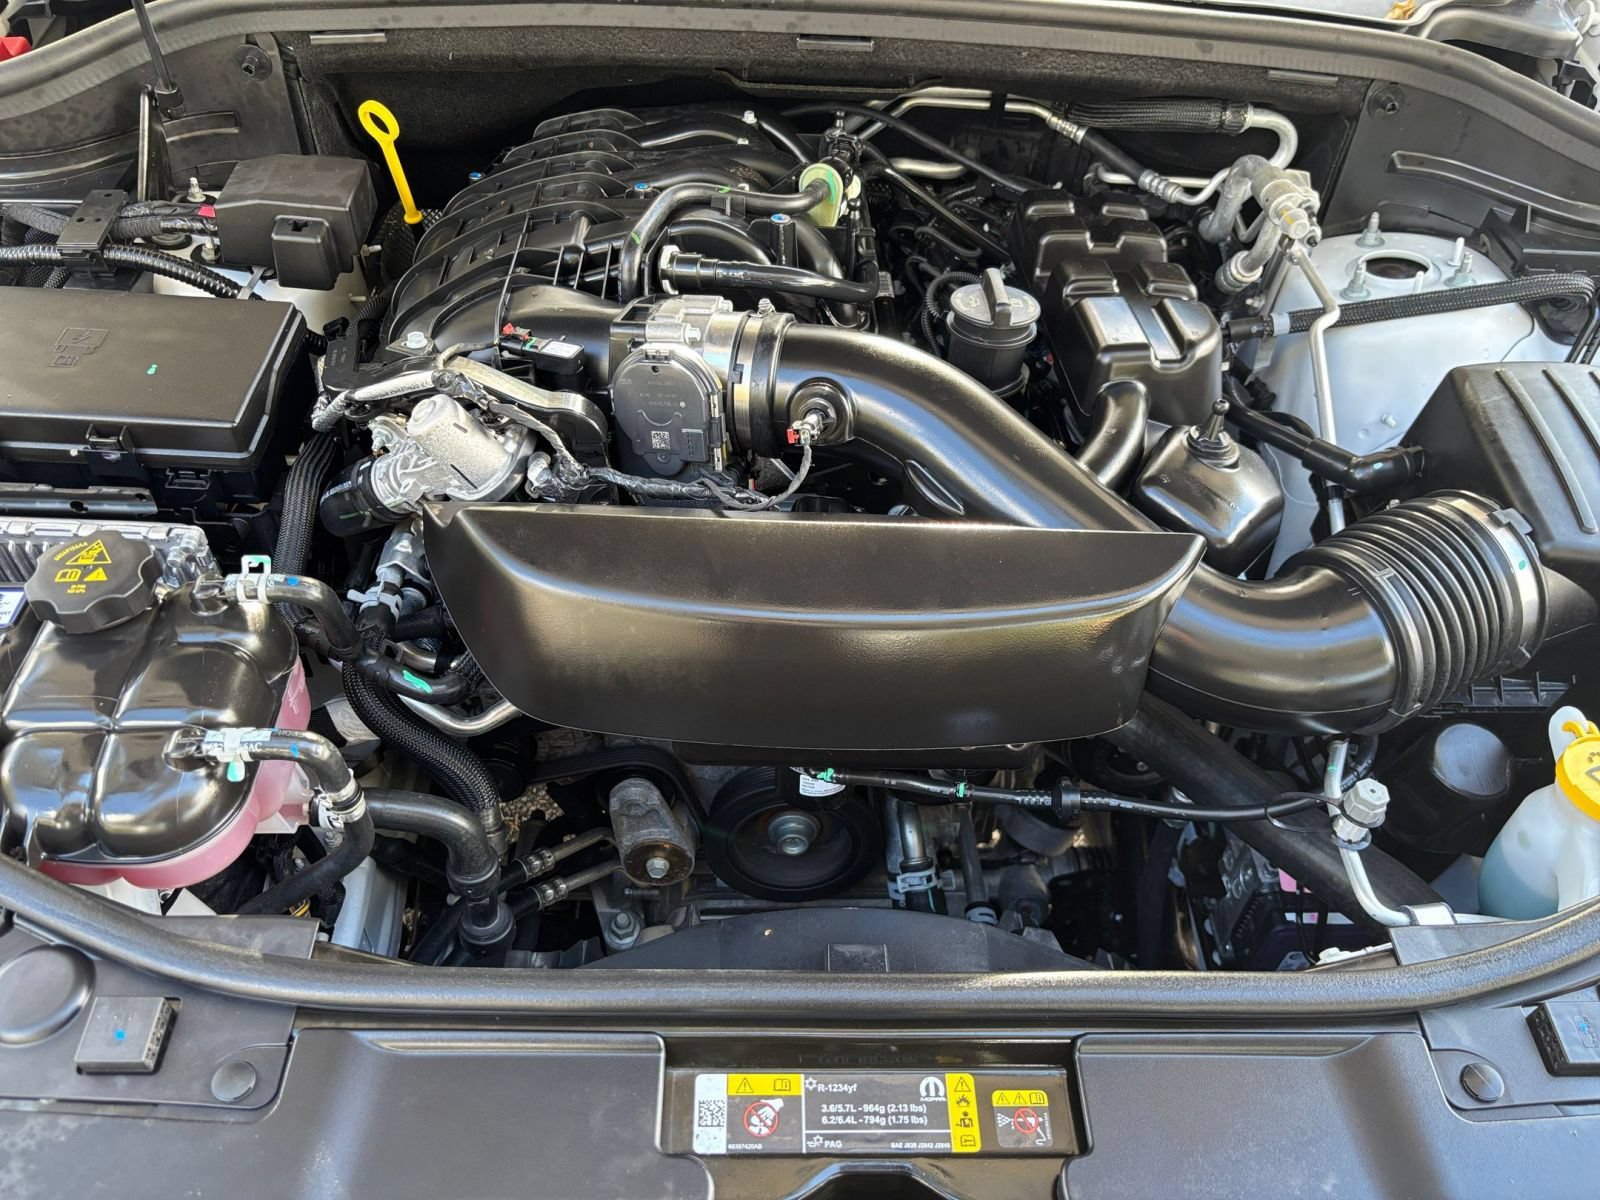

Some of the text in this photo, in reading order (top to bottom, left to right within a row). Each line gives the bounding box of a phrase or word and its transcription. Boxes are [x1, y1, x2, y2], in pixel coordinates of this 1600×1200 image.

[817, 1083, 858, 1094] R-1234yf
[821, 1103, 857, 1113] 3.6/5.7L
[887, 1103, 909, 1114] (2.13
[910, 1103, 927, 1114] lbs)
[821, 1115, 858, 1125] 6.2/6.4L
[888, 1115, 910, 1126] (1.75
[911, 1115, 928, 1126] lbs)
[824, 1140, 843, 1149] PAG
